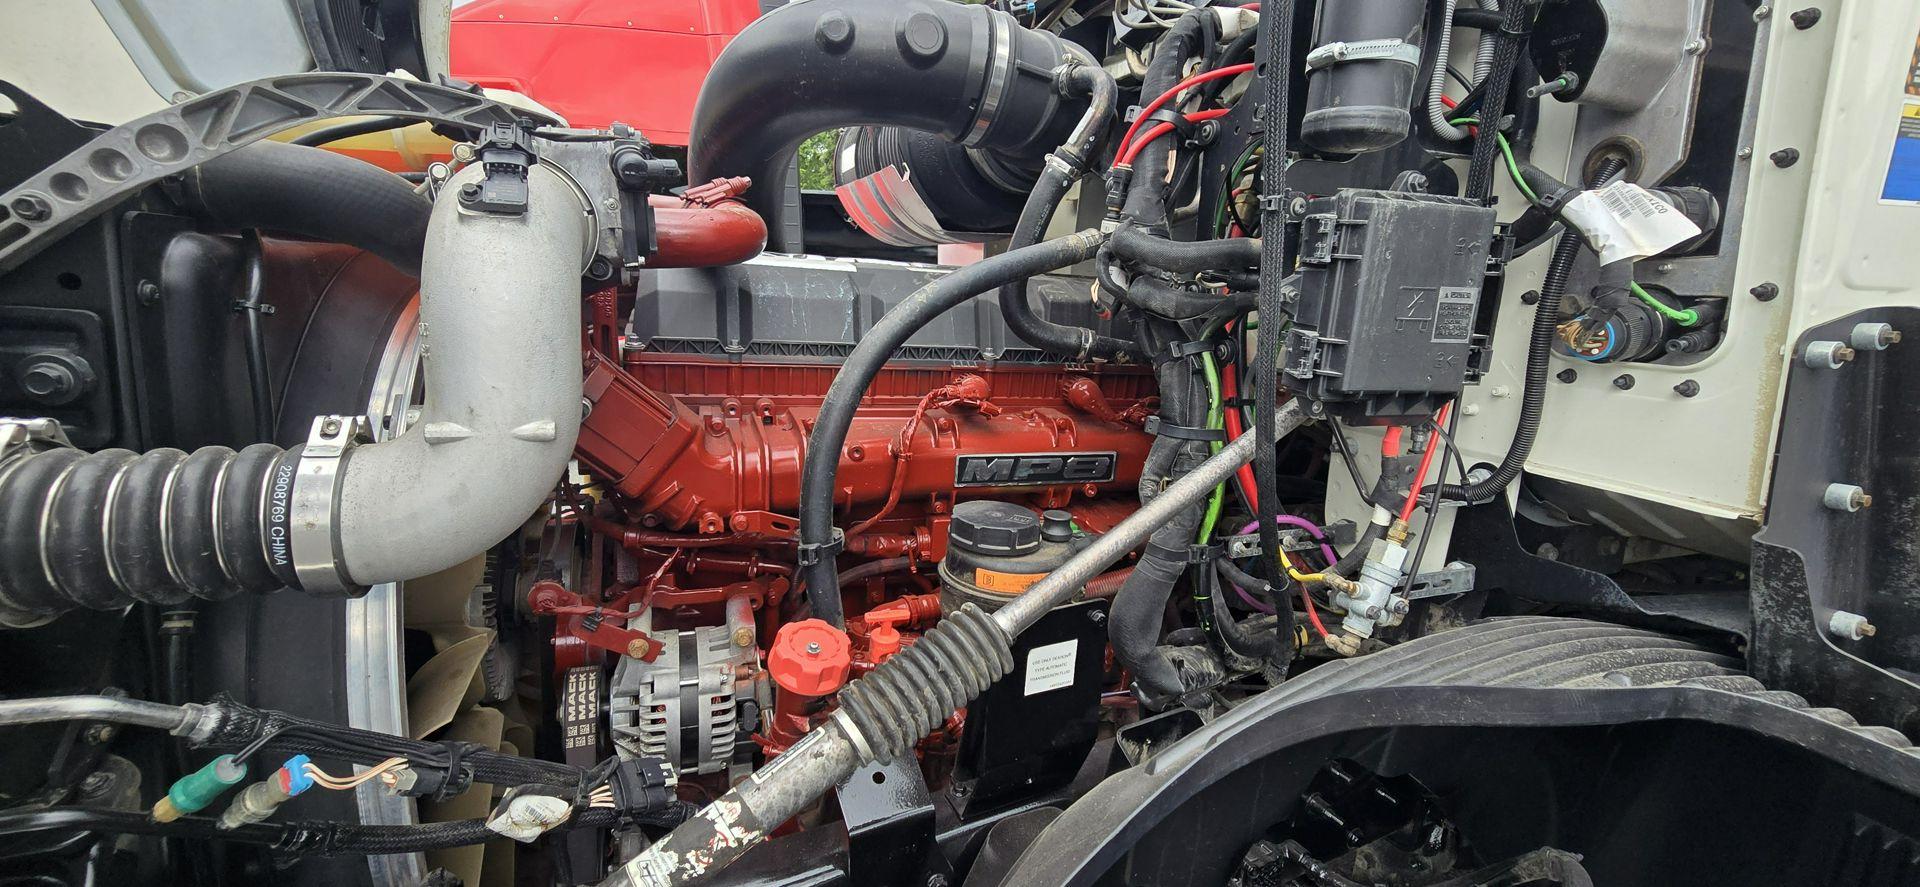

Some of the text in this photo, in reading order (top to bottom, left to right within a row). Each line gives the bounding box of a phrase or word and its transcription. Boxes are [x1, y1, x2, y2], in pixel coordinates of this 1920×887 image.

[961, 458, 1111, 482] MP8
[271, 465, 292, 566] 22908769 CHINA
[568, 674, 576, 721] MACK
[579, 673, 587, 720] MACK
[588, 672, 597, 718] MACK
